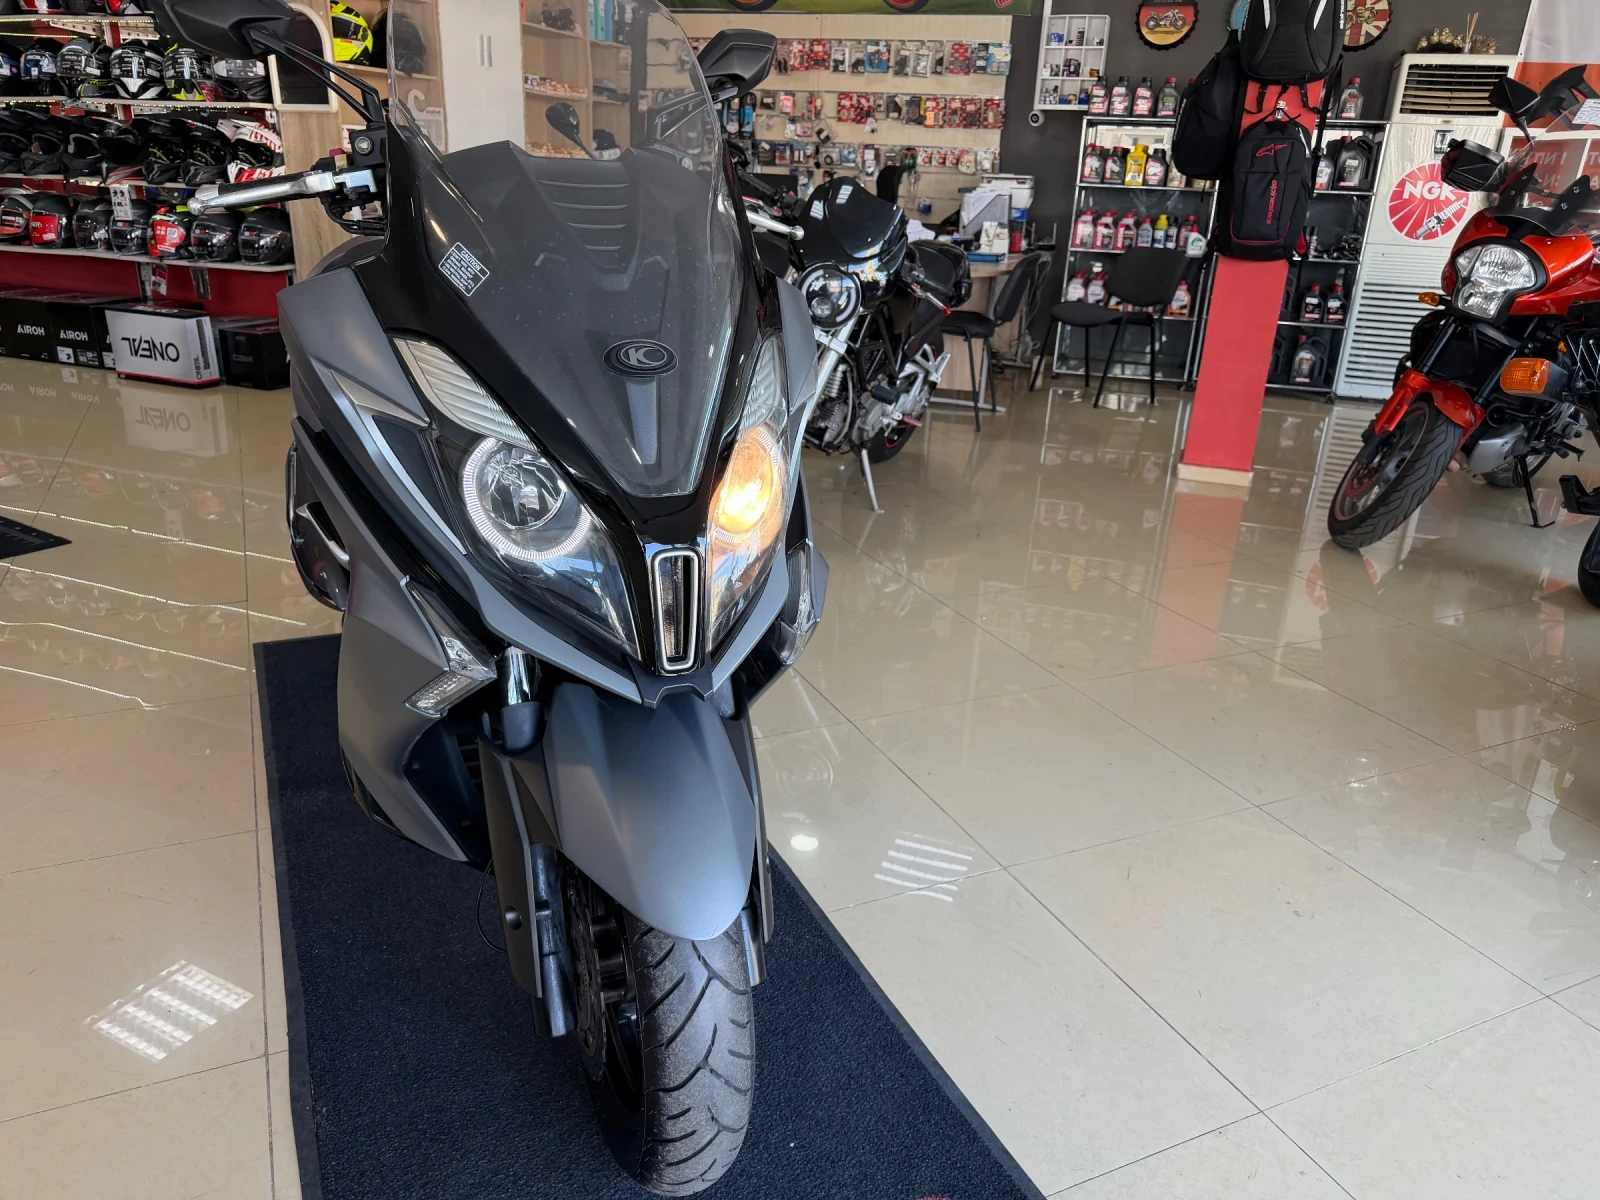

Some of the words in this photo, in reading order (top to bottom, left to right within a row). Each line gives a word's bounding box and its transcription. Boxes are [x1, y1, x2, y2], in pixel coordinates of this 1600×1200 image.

[1403, 181, 1456, 201] NGK
[460, 250, 481, 270] CAUTION
[17, 324, 45, 336] AIROH
[60, 329, 88, 342] AIROH
